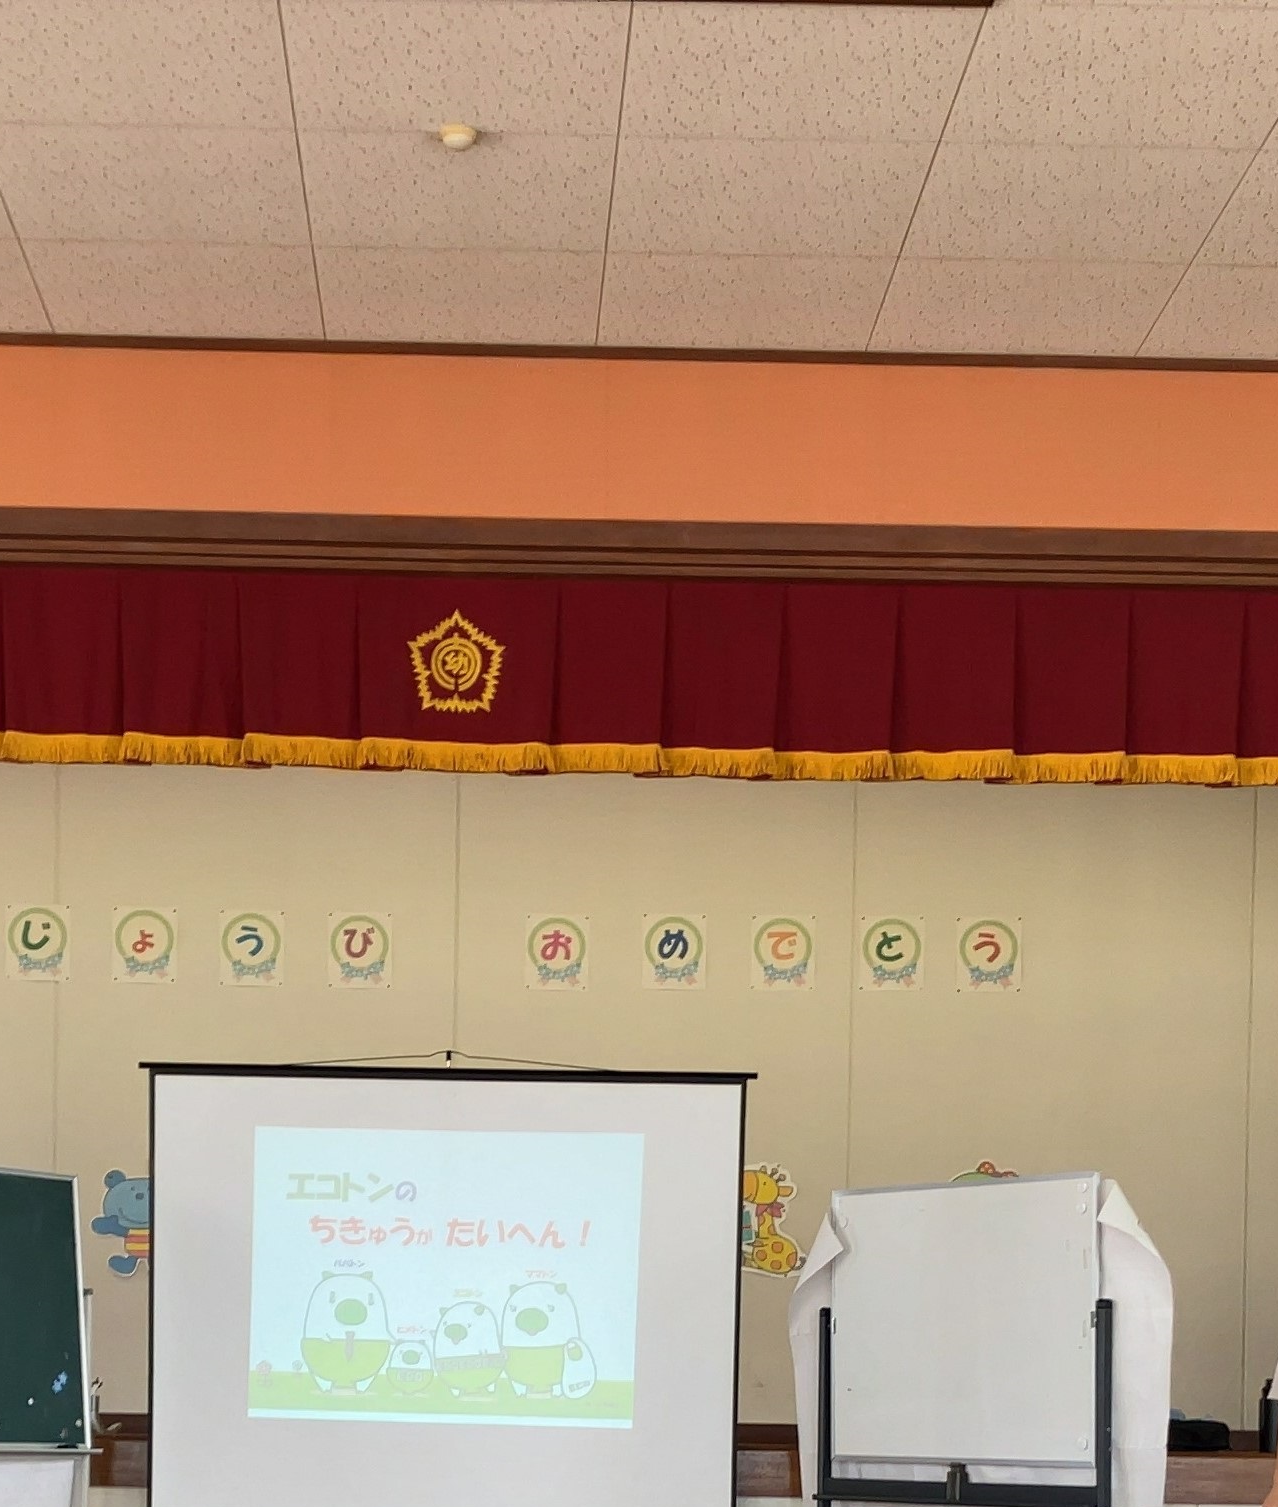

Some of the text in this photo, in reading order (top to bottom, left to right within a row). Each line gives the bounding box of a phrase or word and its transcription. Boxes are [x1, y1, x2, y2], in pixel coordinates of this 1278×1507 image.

[286, 1172, 417, 1202] エコトンの
[308, 1214, 433, 1245] ちきゅうが
